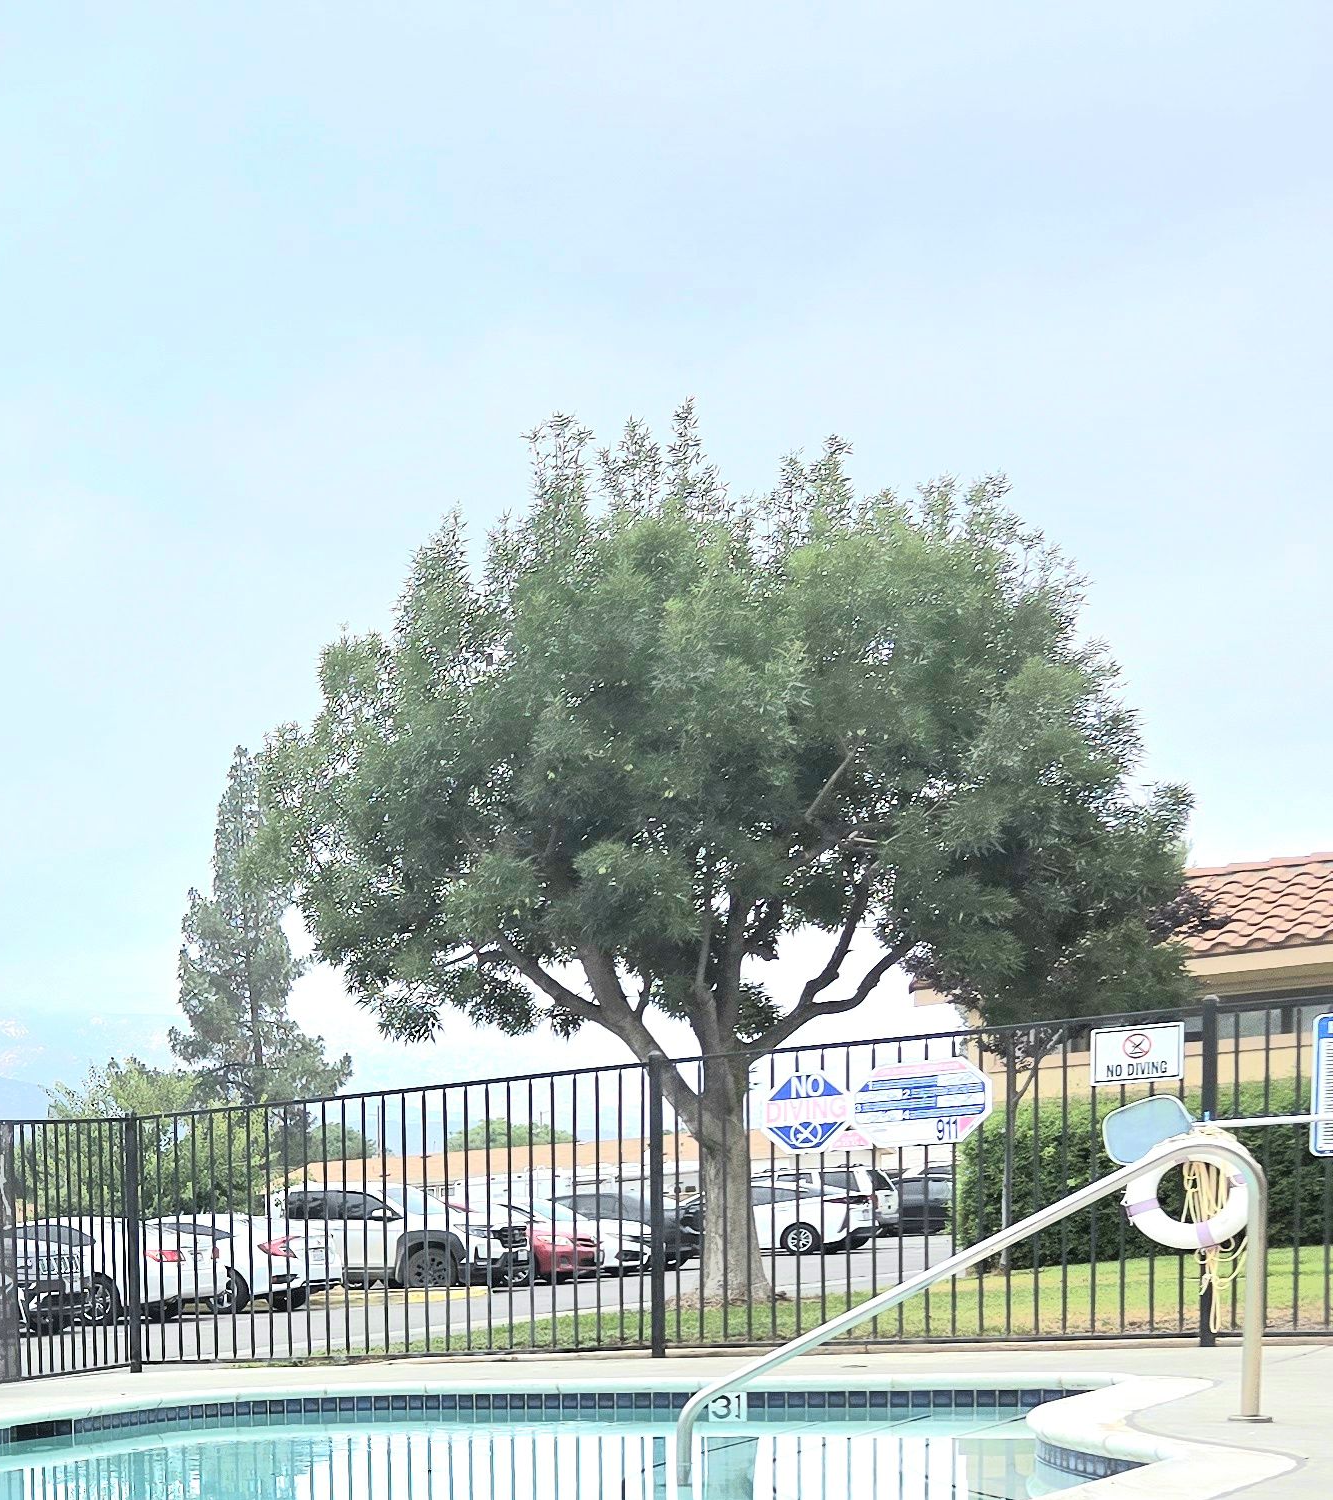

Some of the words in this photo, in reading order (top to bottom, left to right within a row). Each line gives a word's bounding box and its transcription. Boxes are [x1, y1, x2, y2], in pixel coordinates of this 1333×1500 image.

[1106, 1064, 1123, 1078] NO
[1127, 1060, 1168, 1076] DIVING
[791, 1074, 825, 1098] NO
[766, 1096, 847, 1124] DIVING
[936, 1118, 959, 1141] 911
